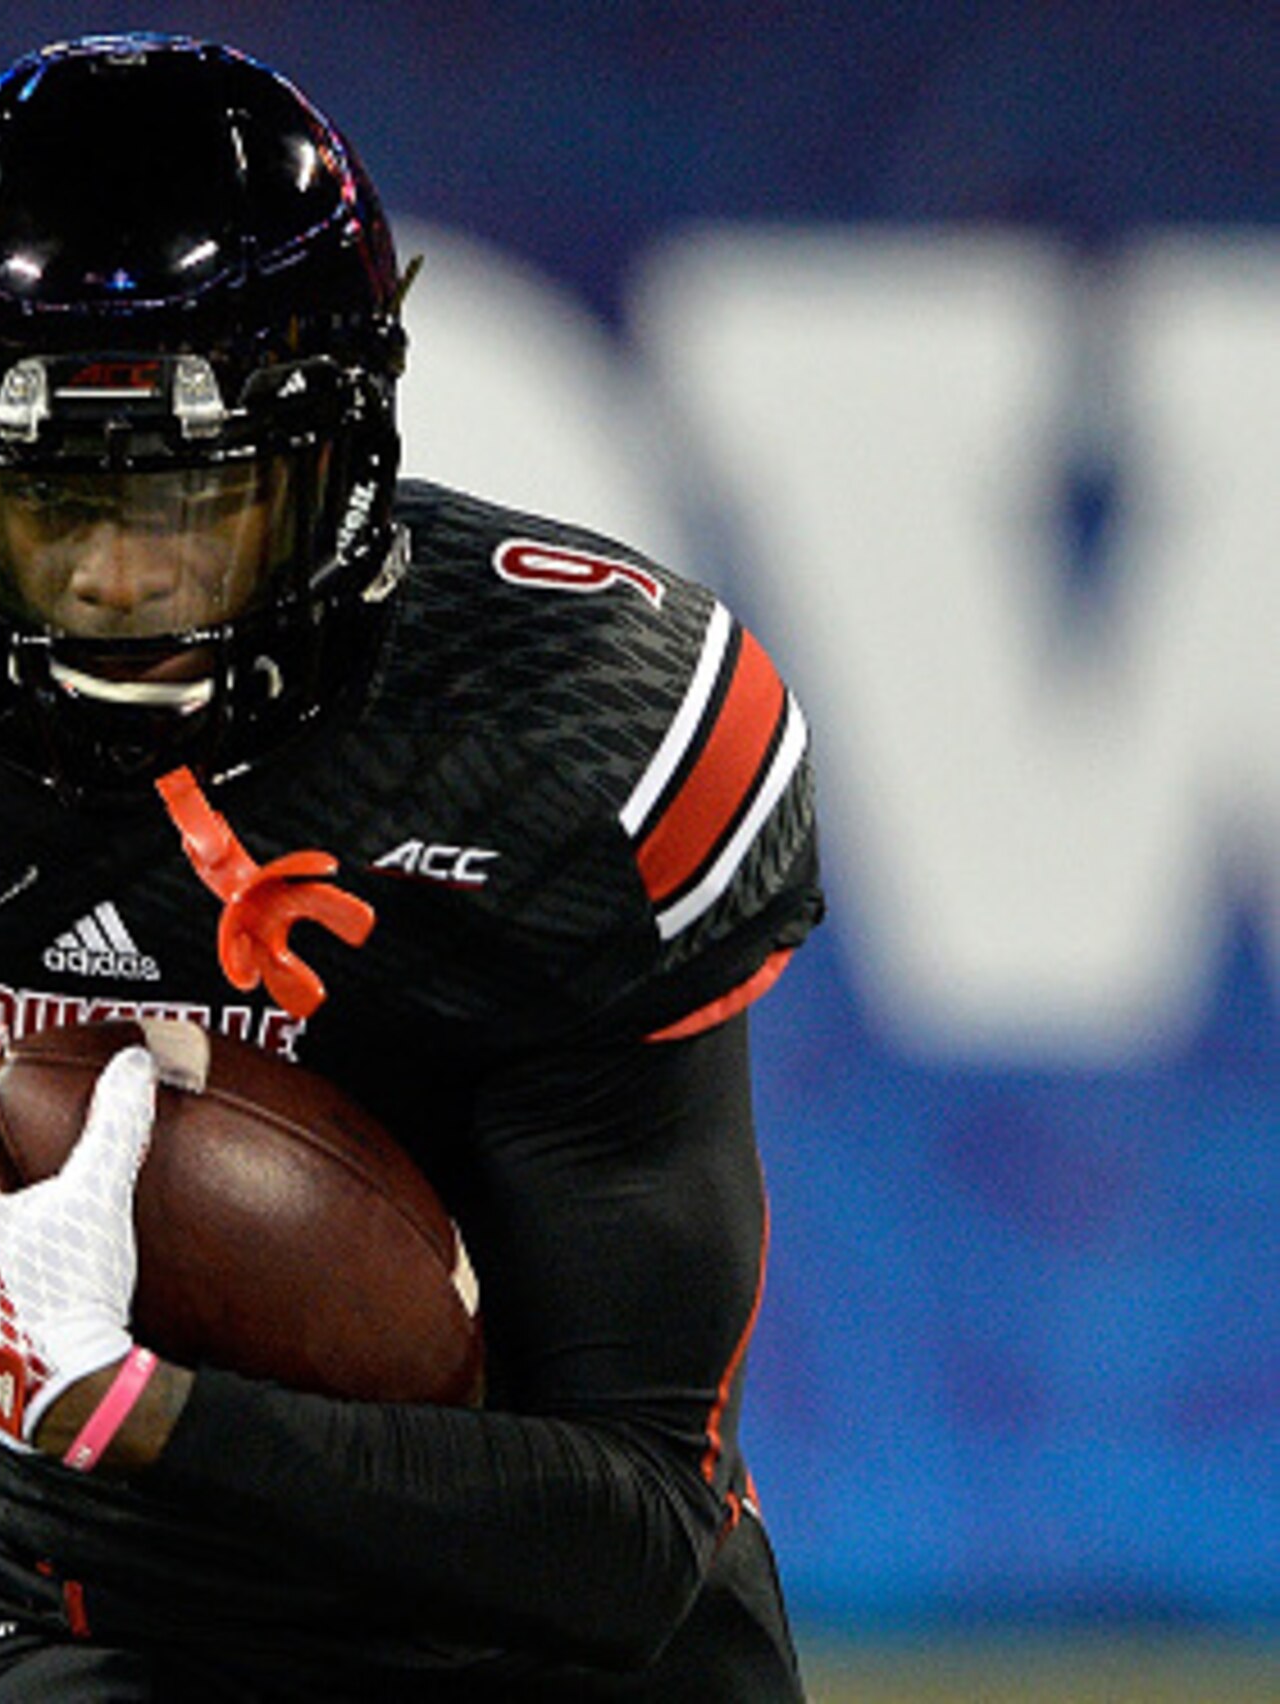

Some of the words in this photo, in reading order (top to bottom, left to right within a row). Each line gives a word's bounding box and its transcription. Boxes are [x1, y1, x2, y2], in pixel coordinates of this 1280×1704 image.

[492, 538, 666, 610] 9
[372, 838, 501, 882] ACC
[43, 947, 161, 981] adidas
